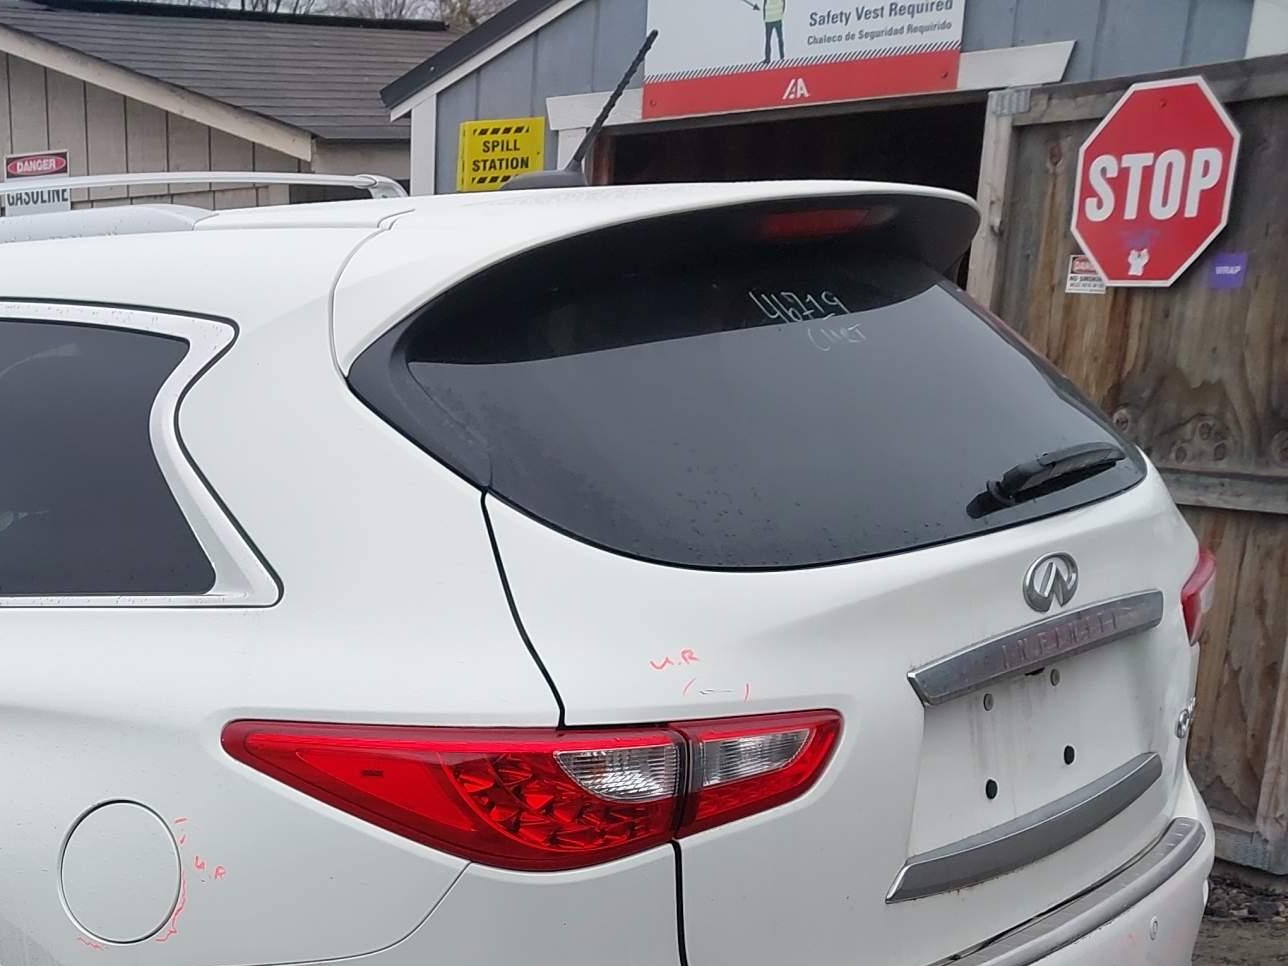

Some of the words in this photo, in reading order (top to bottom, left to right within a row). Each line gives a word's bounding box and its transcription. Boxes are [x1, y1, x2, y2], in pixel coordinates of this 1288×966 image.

[809, 9, 852, 27] Safety
[855, 5, 885, 21] Vest
[888, 0, 953, 18] Required
[807, 33, 843, 46] Chaleco
[844, 31, 856, 41] de
[858, 25, 905, 41] Seguridad
[482, 139, 521, 153] SPILL
[16, 158, 56, 174] DANGER
[472, 156, 530, 173] STATION
[1085, 147, 1223, 222] STOP
